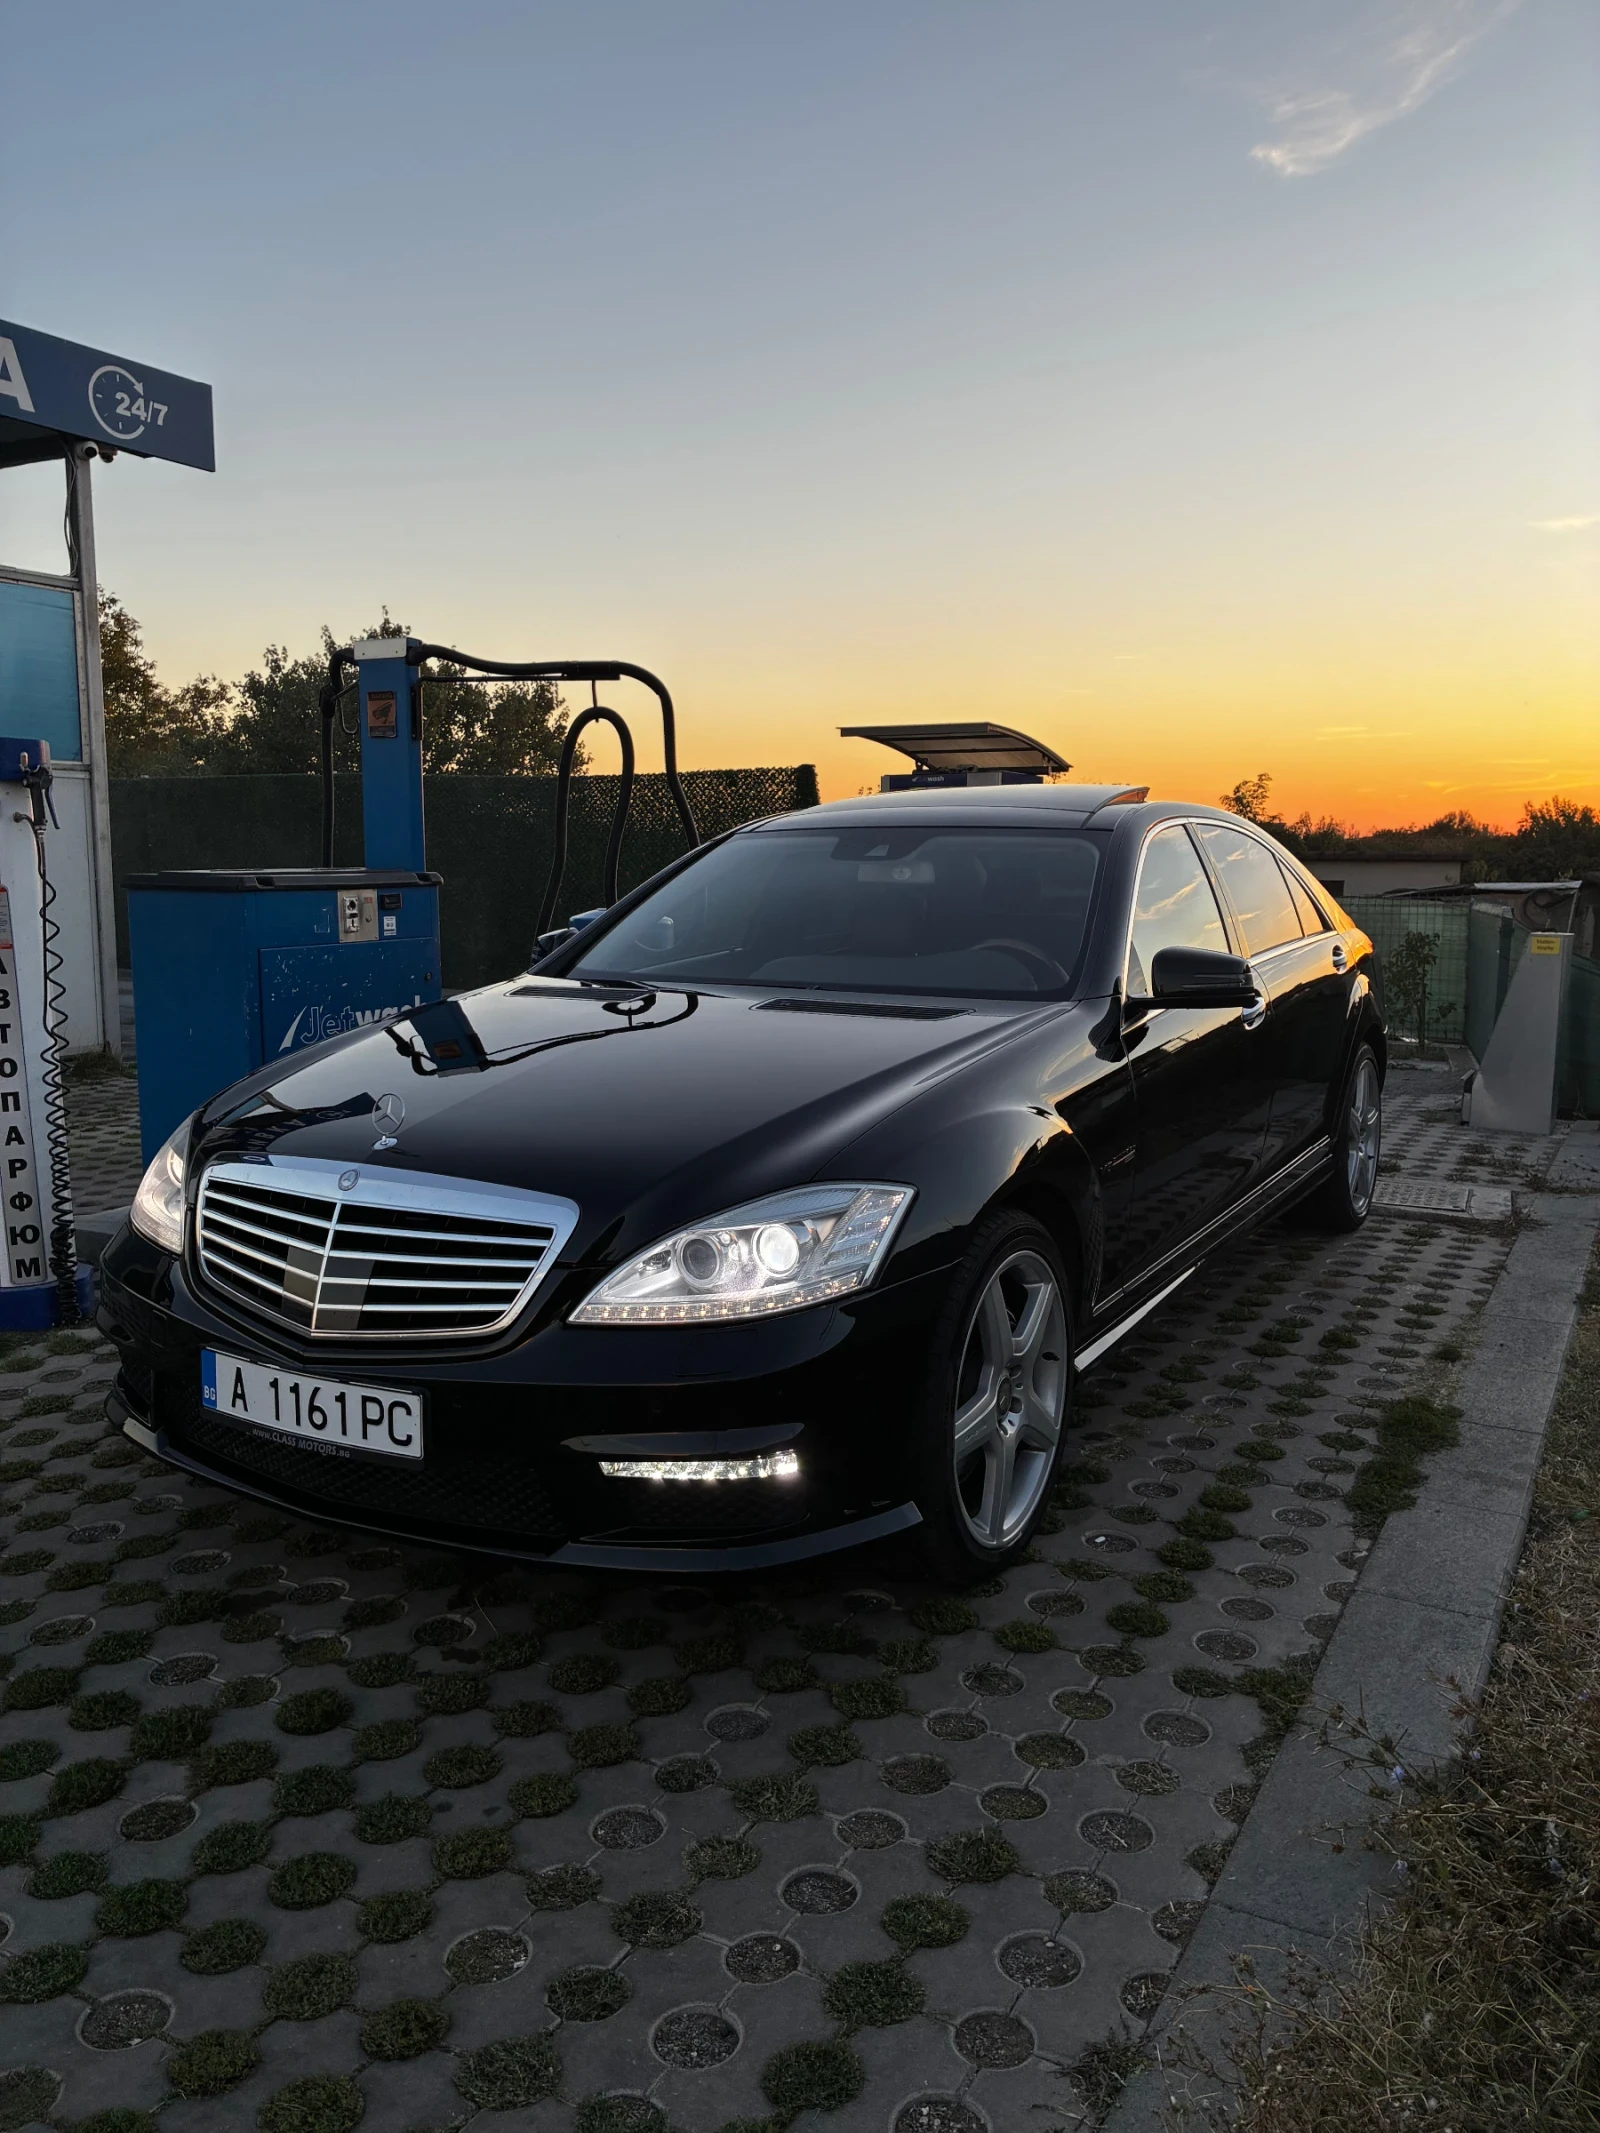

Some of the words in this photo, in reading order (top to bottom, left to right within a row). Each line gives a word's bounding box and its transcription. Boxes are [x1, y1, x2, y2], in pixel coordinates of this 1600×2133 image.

[115, 391, 168, 426] 24/7
[203, 1384, 216, 1401] BG
[231, 1365, 249, 1412] A
